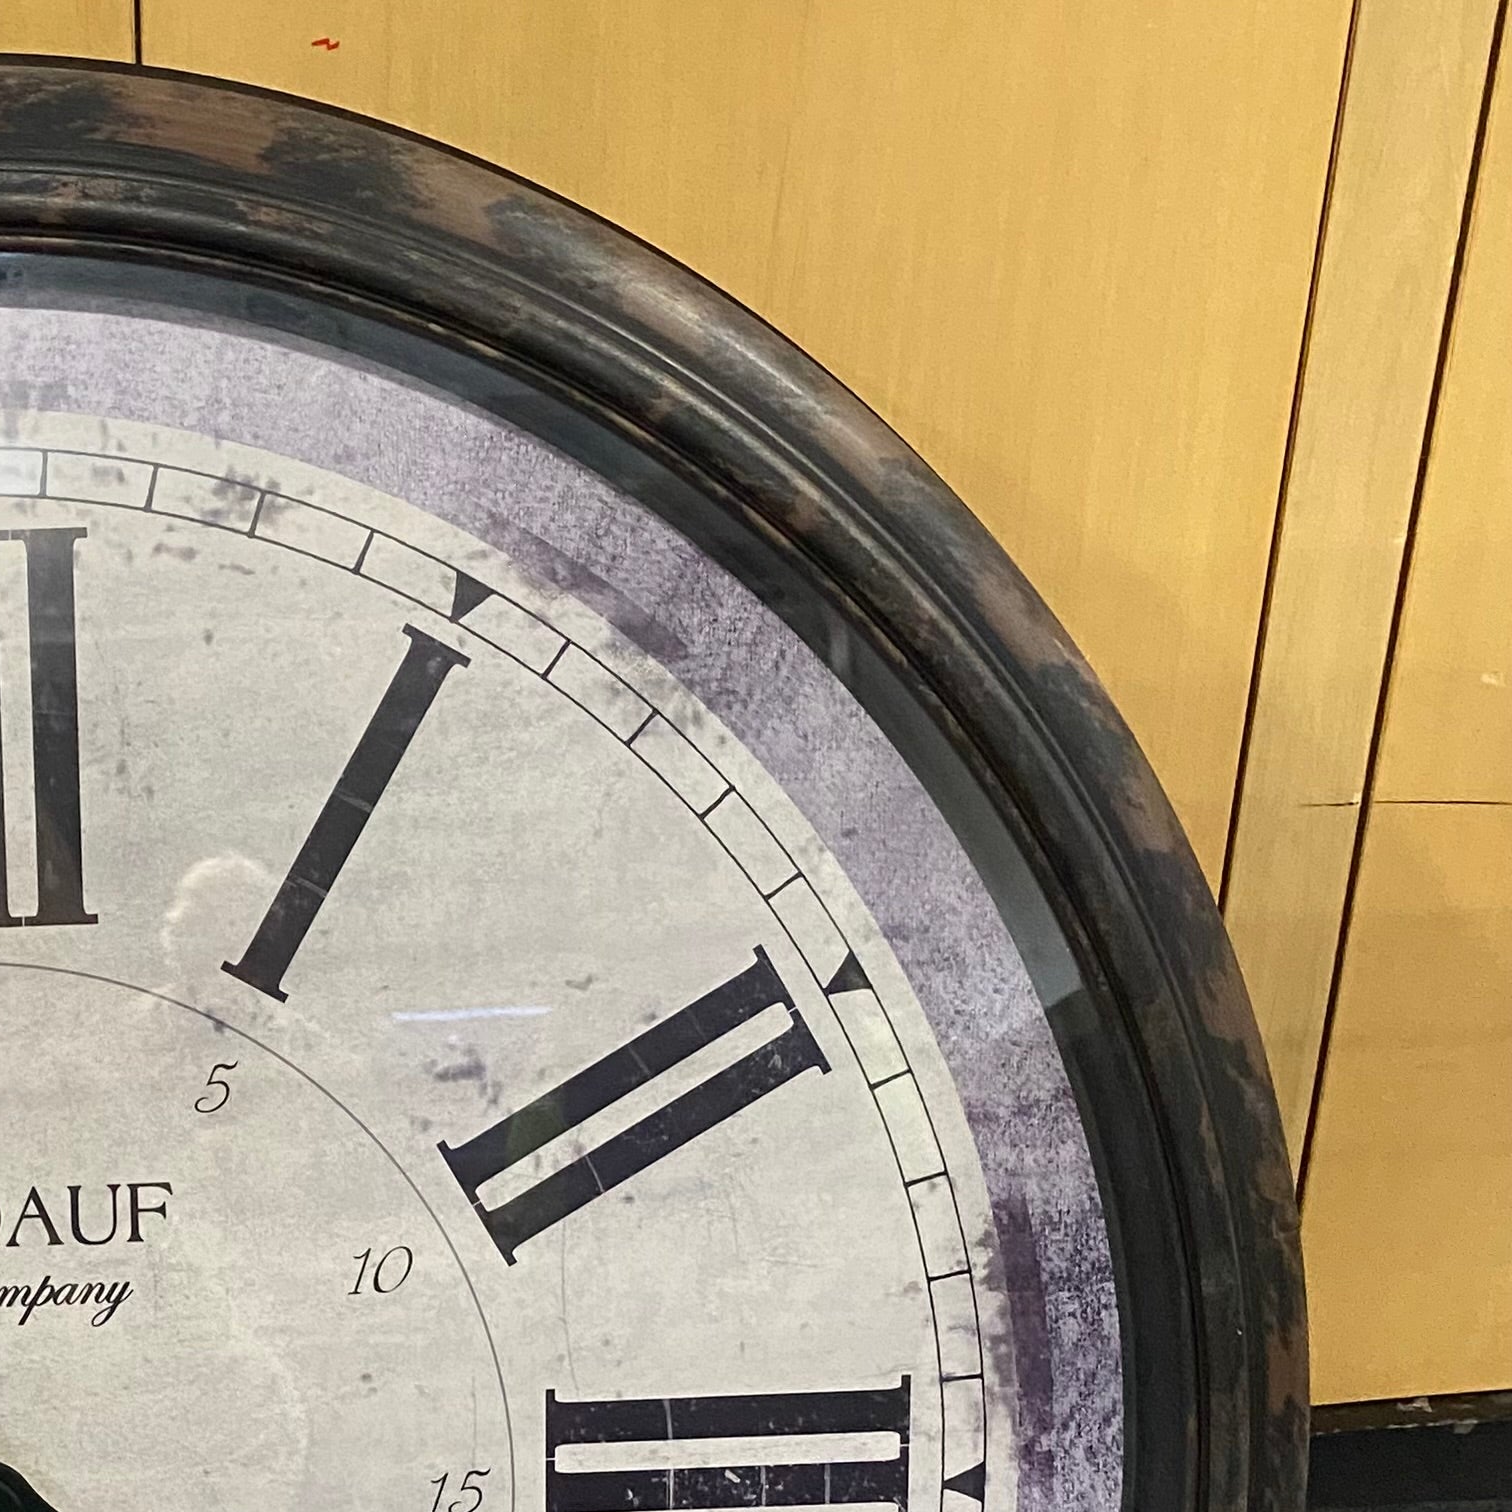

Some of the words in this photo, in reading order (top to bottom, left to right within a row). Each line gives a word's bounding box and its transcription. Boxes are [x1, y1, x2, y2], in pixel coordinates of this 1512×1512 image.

[193, 1060, 239, 1114] 5
[436, 944, 832, 1266] II
[347, 1245, 414, 1296] 10
